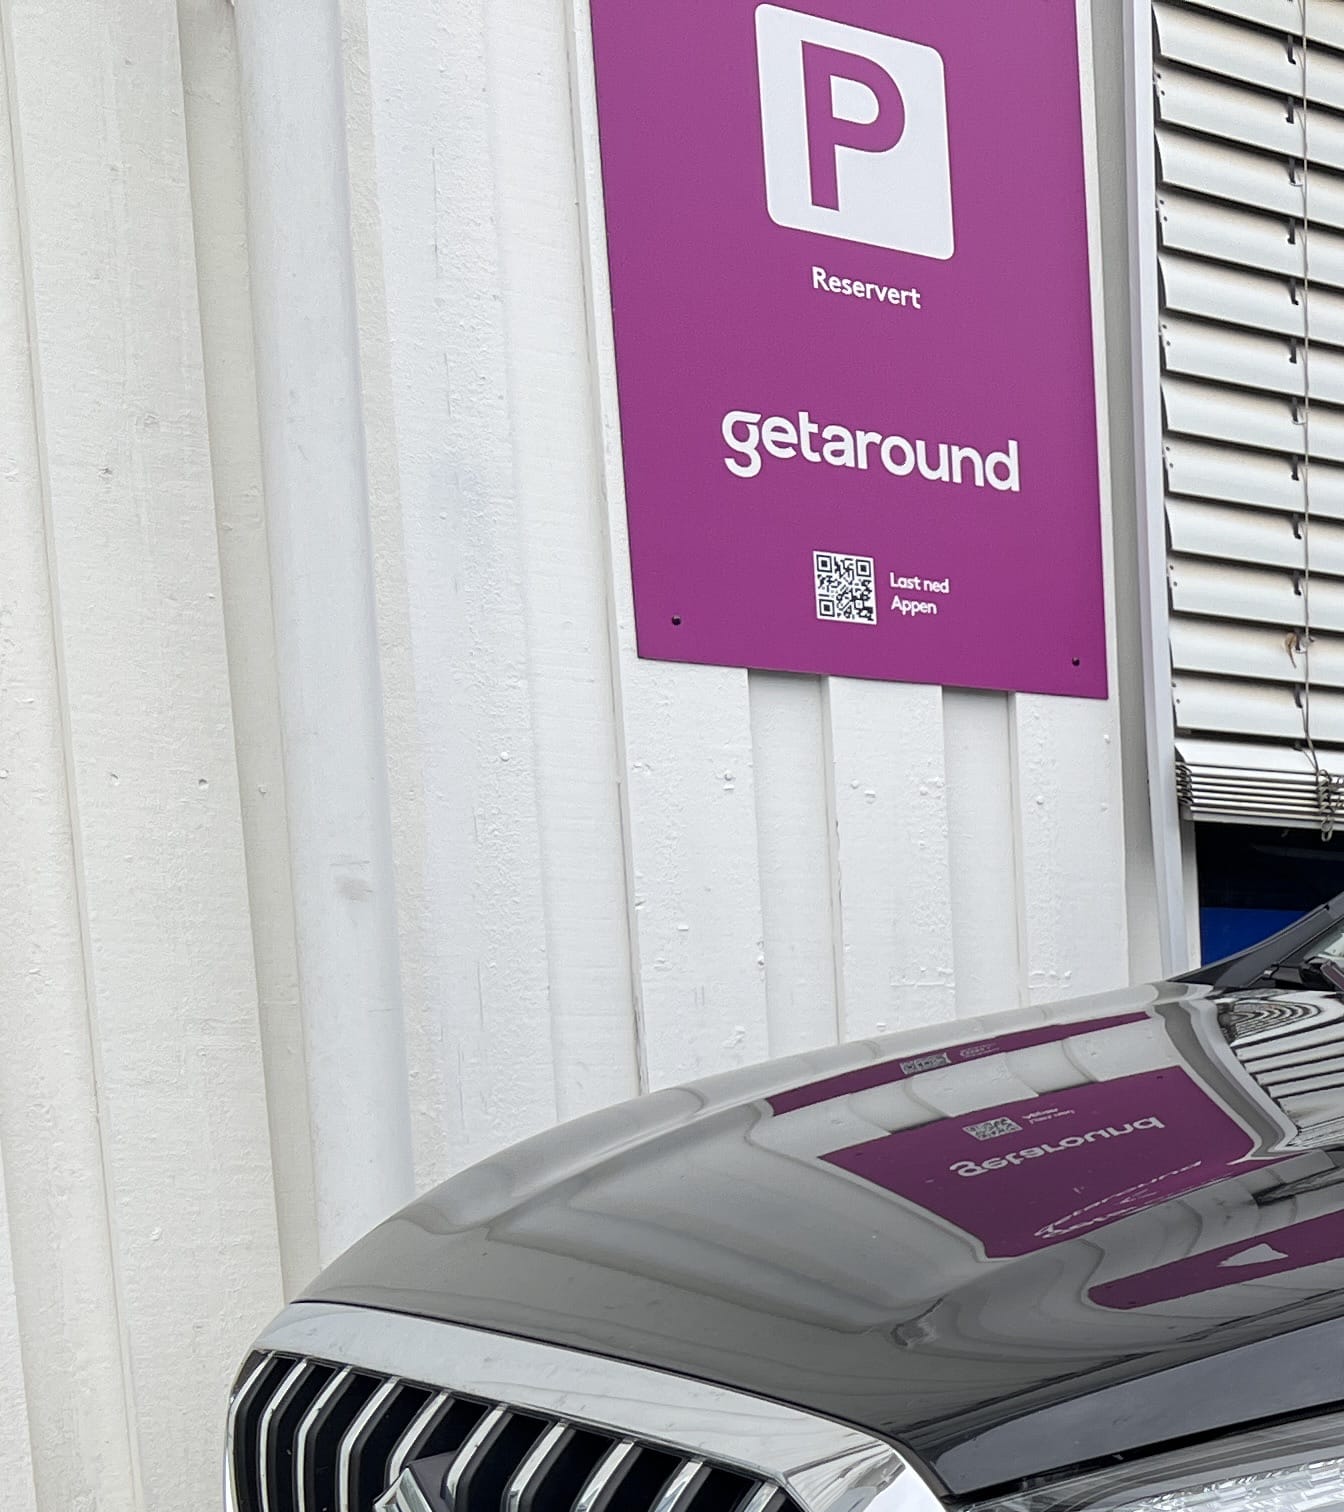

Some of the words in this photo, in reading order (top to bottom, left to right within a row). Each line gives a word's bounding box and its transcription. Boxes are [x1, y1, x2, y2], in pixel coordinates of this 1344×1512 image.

[801, 40, 906, 212] P
[812, 266, 921, 309] Reservert
[721, 409, 1021, 493] getaround
[889, 571, 921, 590] Last
[923, 578, 949, 593] ned
[890, 595, 937, 616] Appen
